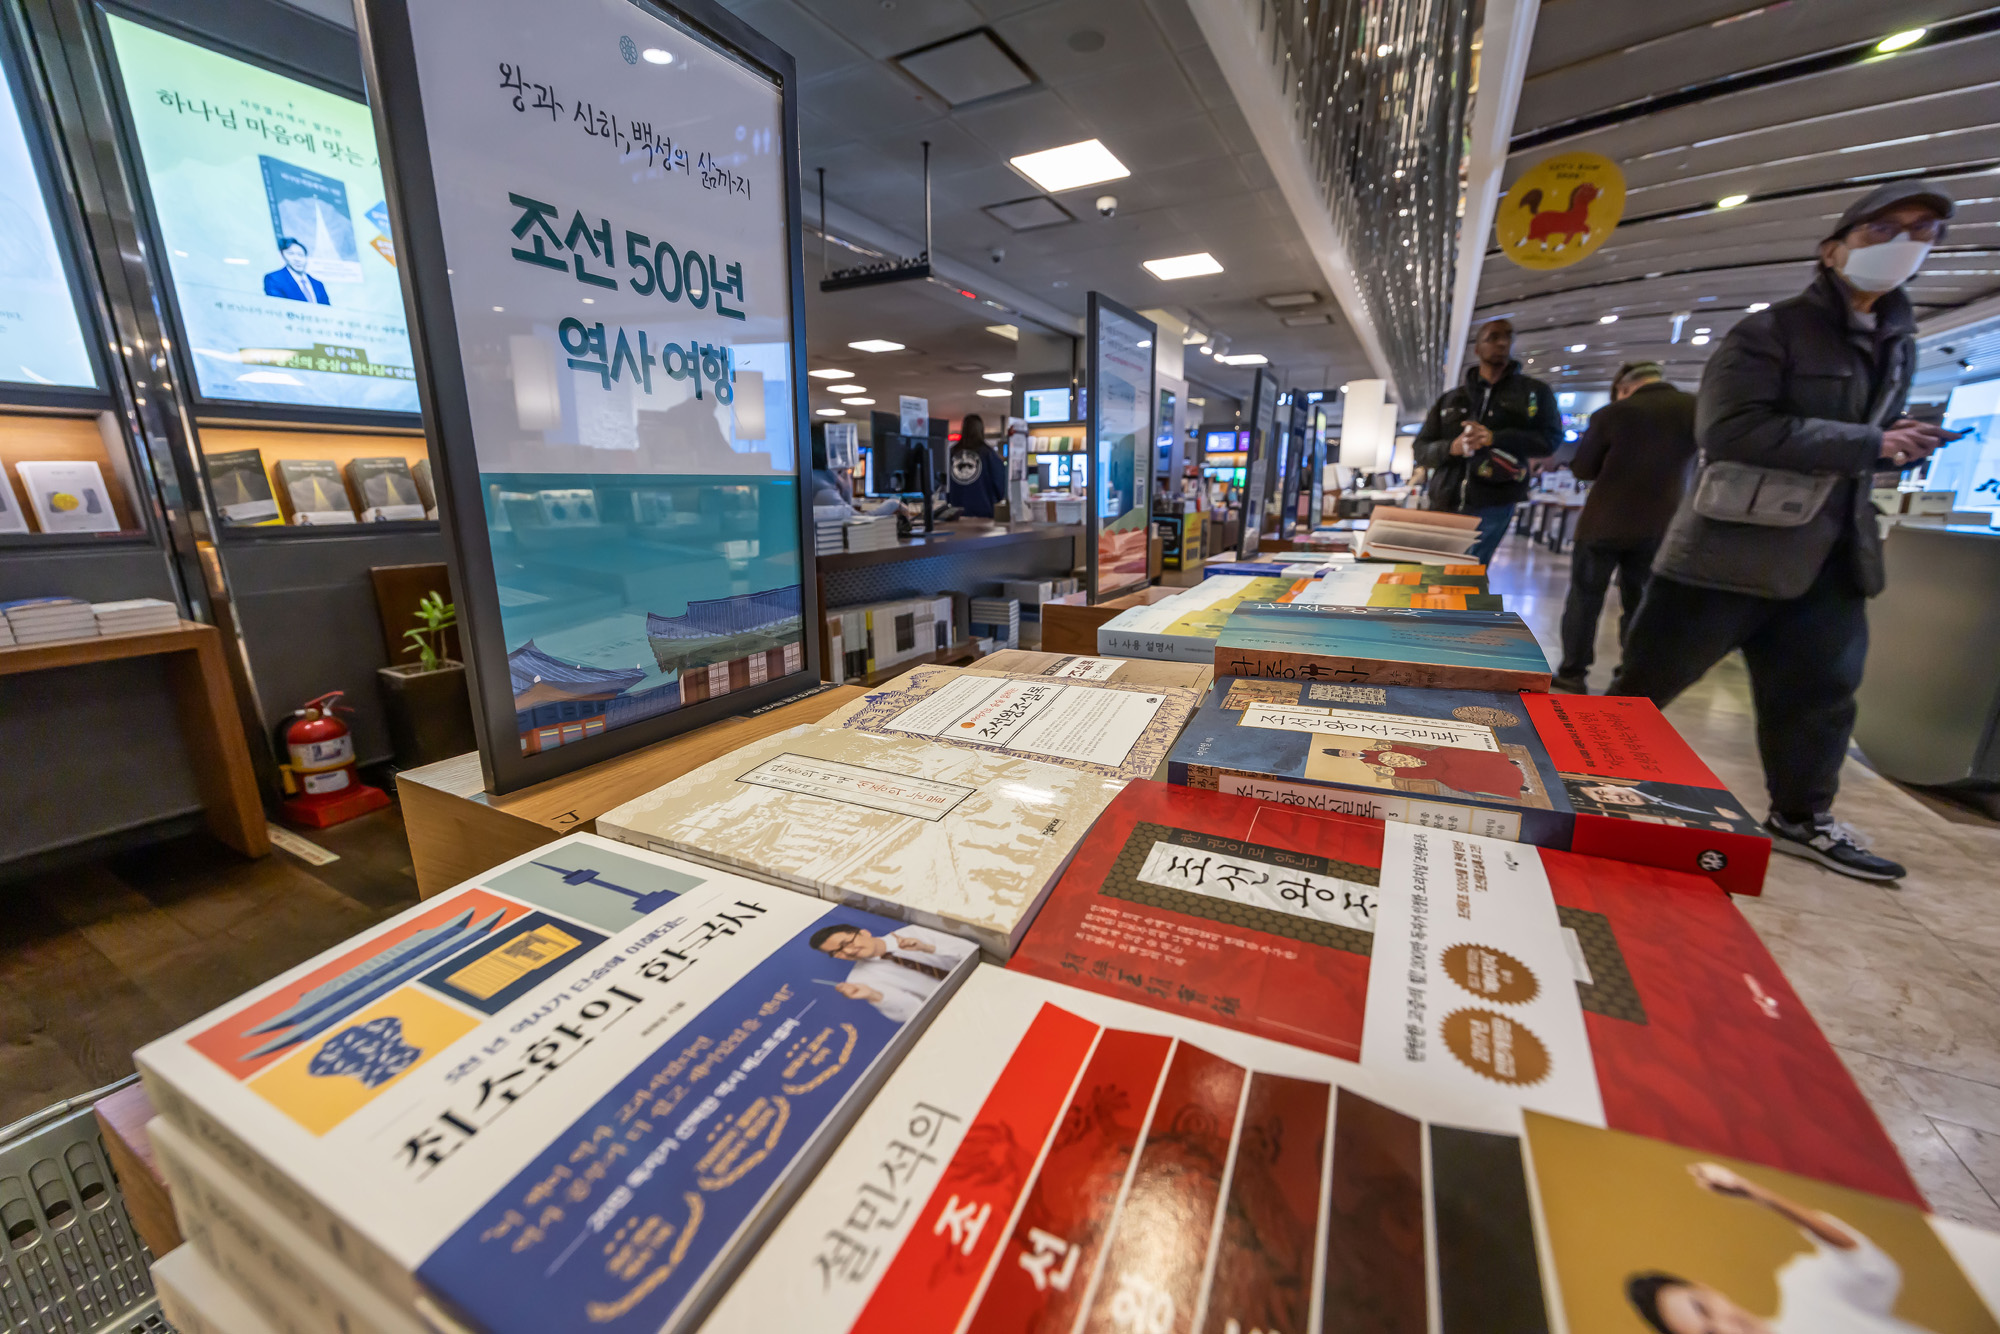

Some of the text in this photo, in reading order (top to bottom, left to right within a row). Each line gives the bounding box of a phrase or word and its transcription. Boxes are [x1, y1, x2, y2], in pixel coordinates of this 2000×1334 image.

[156, 89, 365, 167] 하나님 마음에 맞는
[499, 63, 564, 121] 왕과
[698, 152, 751, 200] 삶까지
[508, 191, 746, 321] 조선 500년
[558, 316, 736, 405] 역사 여행
[1109, 639, 1118, 647] 나
[1122, 640, 1140, 651] 사용
[1146, 640, 1174, 652] 설명서
[978, 685, 1051, 740] 조선왕조실록
[1261, 714, 1467, 744] 조선왕조실록
[1180, 833, 1319, 870] 한 권으로 읽는
[510, 992, 570, 1034] 역사가
[569, 955, 625, 993] 단숨에
[625, 915, 688, 956] 이해되는
[394, 984, 644, 1183] 최소한의
[635, 899, 769, 984] 한국사
[812, 1099, 962, 1290] 설민석의
[932, 1194, 992, 1256] 조
[1018, 1227, 1082, 1292] 선
